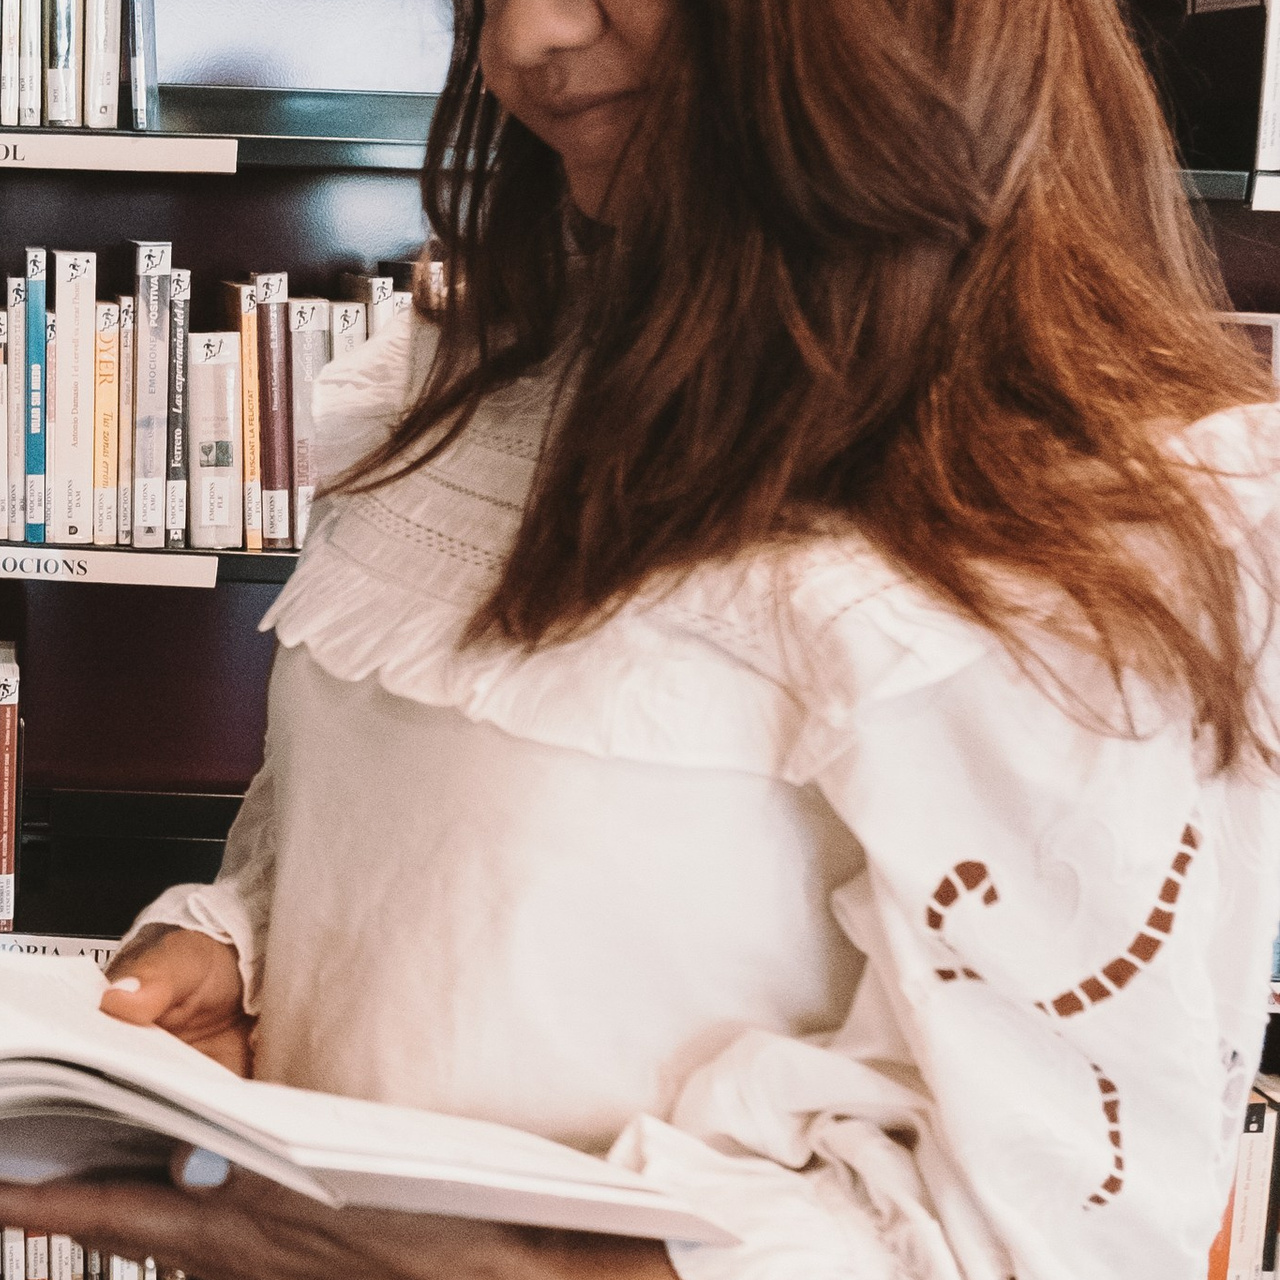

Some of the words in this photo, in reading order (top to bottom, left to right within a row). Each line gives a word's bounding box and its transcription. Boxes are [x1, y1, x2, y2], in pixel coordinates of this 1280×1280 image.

[173, 313, 183, 326] del
[173, 327, 185, 392] experiencias
[303, 351, 313, 381] Daniel
[70, 381, 79, 415] Damasio
[172, 394, 183, 414] Las
[247, 389, 255, 426] FELICITAT
[70, 417, 79, 449] Antonio
[102, 429, 110, 457] zonas
[171, 427, 183, 468] Ferrero
[249, 428, 255, 439] LA
[121, 486, 129, 528] EMOCIONS
[141, 482, 149, 523] EMOCIONS
[169, 485, 177, 525] EMOCIONS
